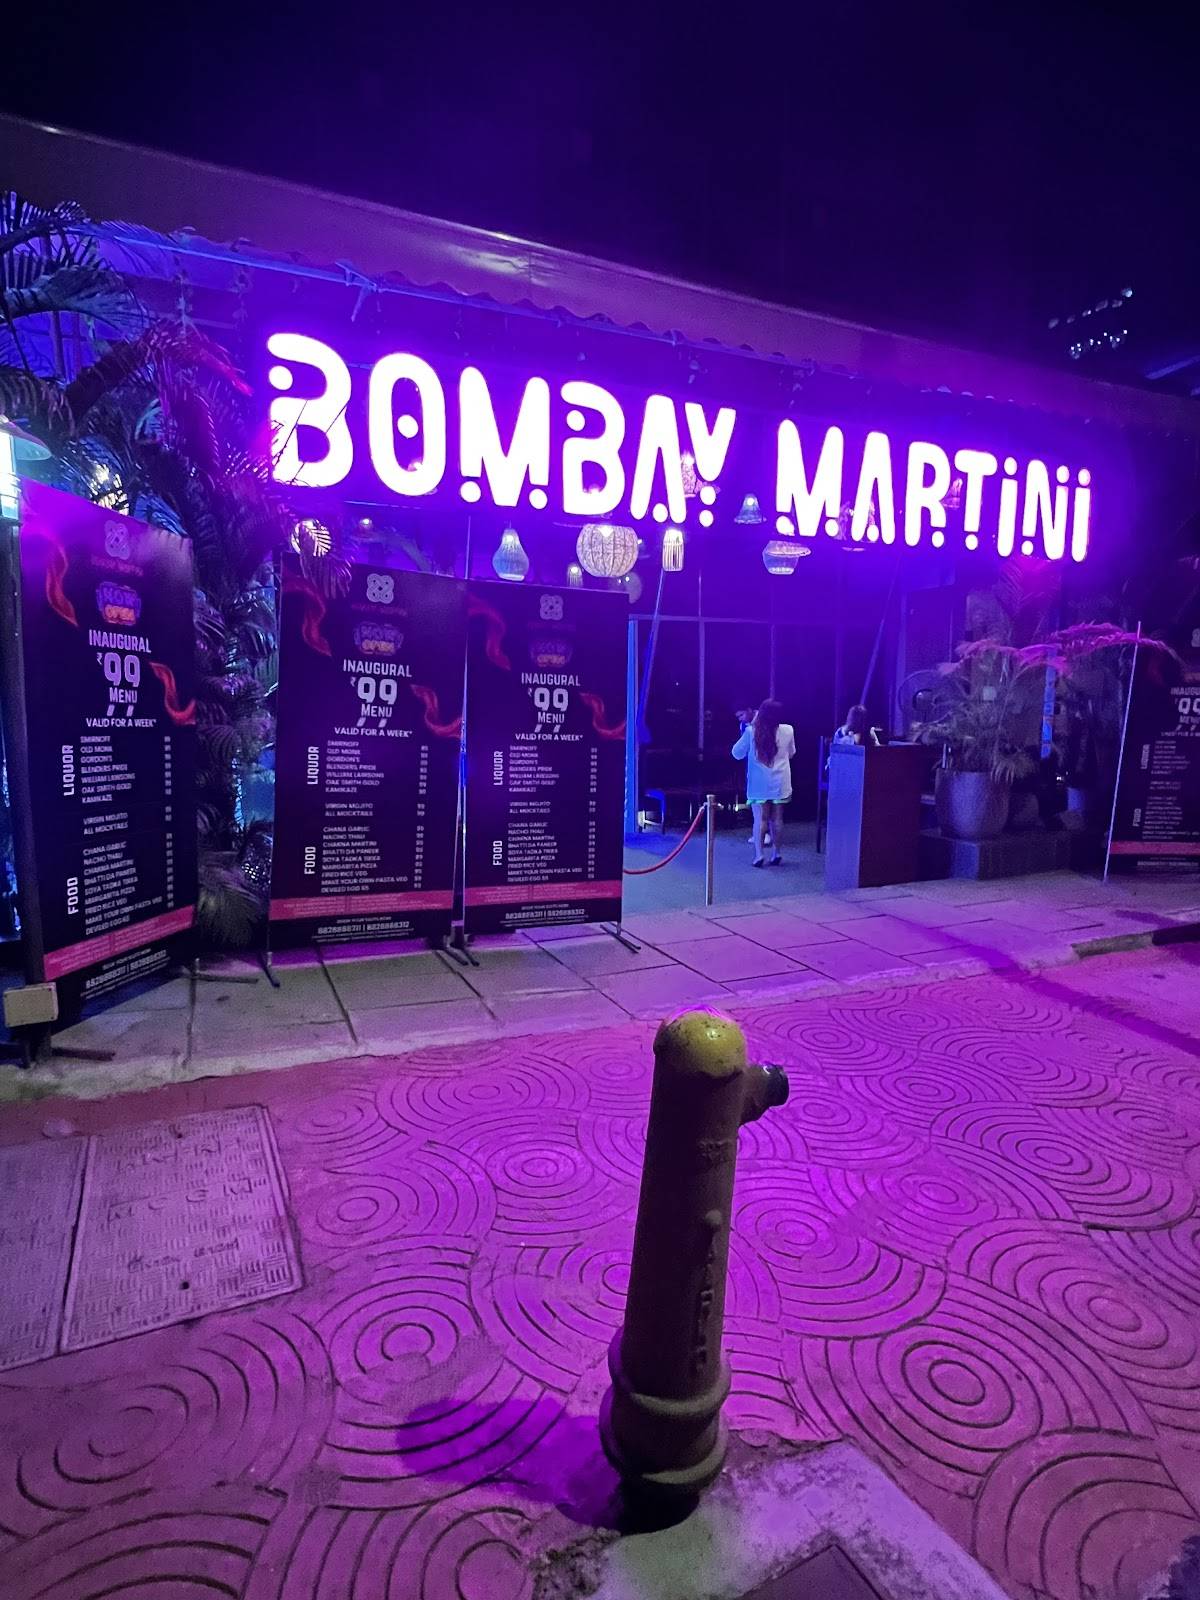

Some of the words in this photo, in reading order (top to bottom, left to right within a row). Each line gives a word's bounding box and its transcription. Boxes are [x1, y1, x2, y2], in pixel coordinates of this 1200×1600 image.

[267, 333, 736, 527] BOMBAY
[776, 419, 1091, 562] MARTINI
[88, 629, 152, 653] INAUGURAL
[343, 659, 412, 677] INAUGURAL
[521, 672, 581, 686] INAUGURAL
[109, 687, 138, 704] MENU
[361, 704, 392, 717] MENU
[538, 711, 565, 723] MENU
[86, 718, 110, 727] VALID
[111, 718, 126, 727] FOR
[127, 718, 133, 727] A
[335, 727, 360, 735] VALID
[361, 728, 378, 736] FOR
[554, 733, 559, 741] A
[62, 745, 75, 796] LIQUOR
[307, 746, 319, 785] LIQUOR
[493, 750, 504, 785] LIQUOR
[304, 846, 316, 875] FOOD
[493, 840, 503, 866] FOOD
[67, 877, 79, 915] FOOD
